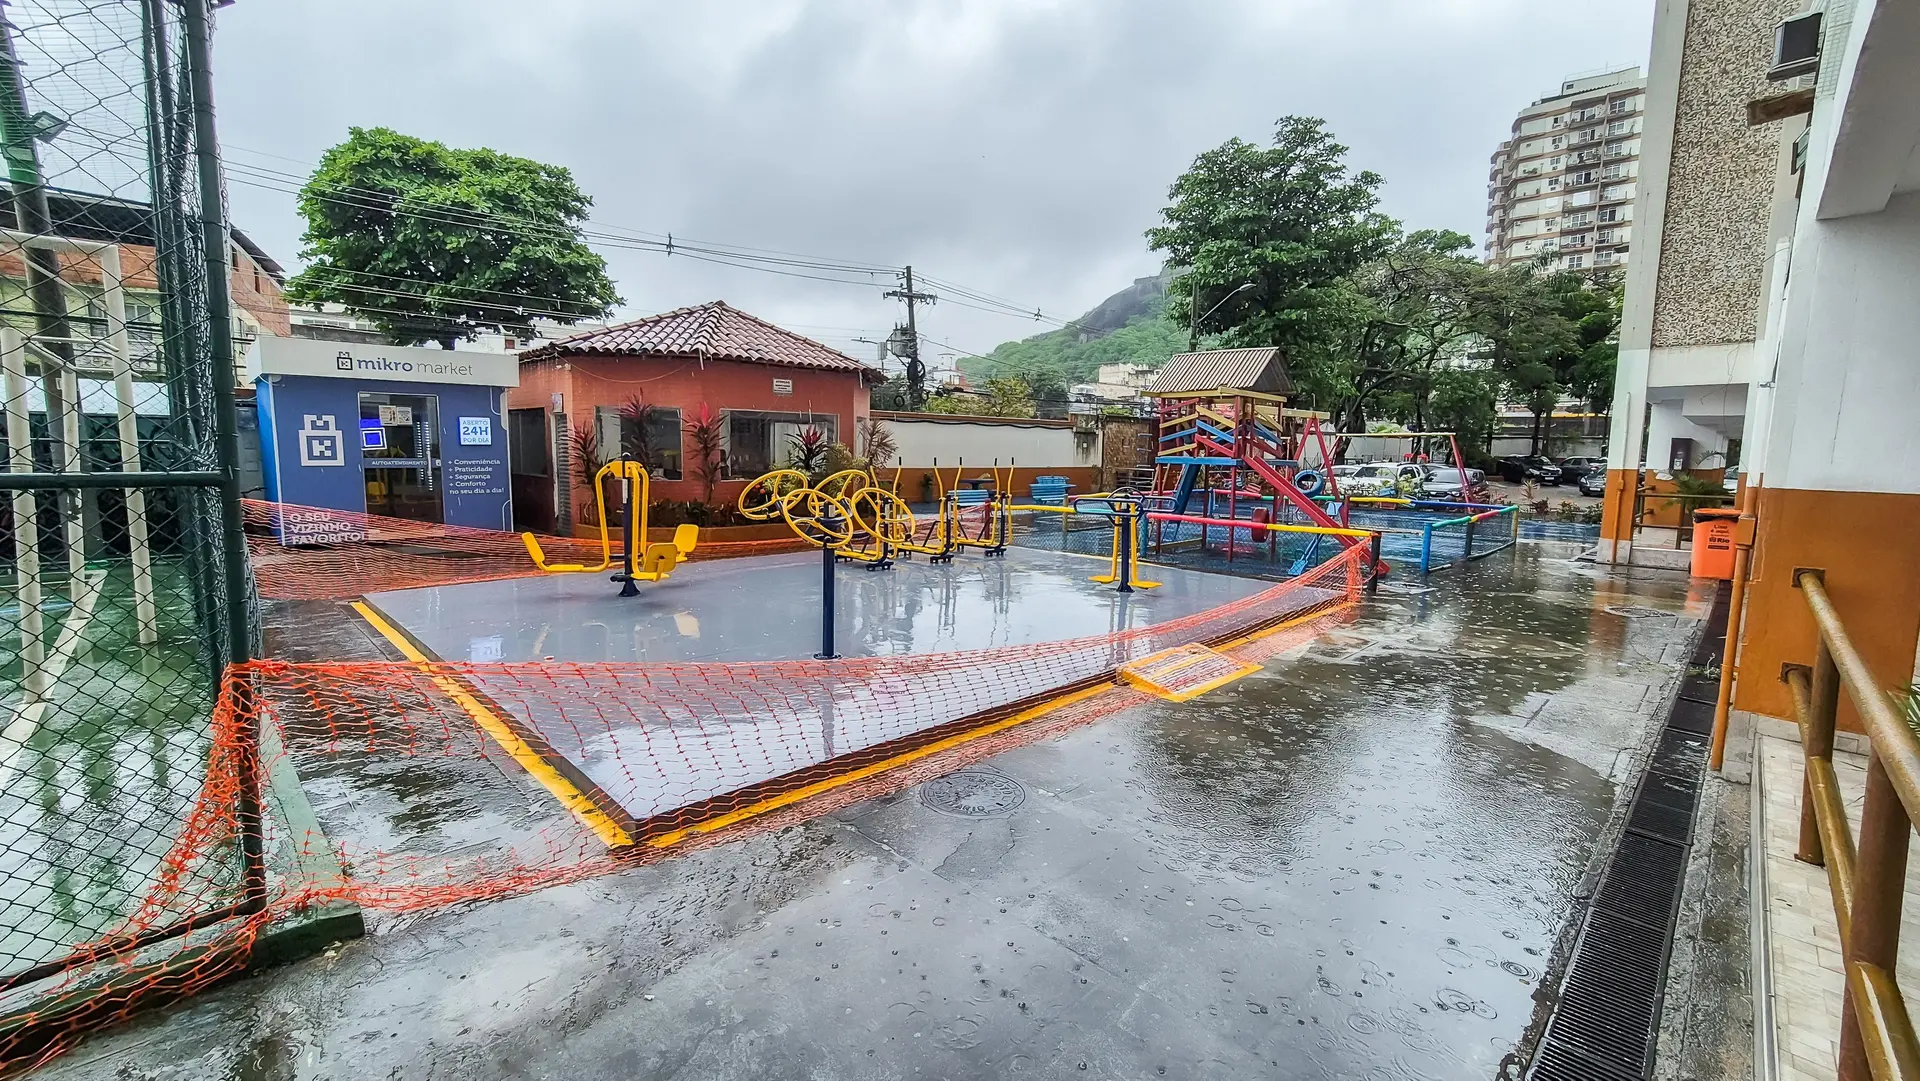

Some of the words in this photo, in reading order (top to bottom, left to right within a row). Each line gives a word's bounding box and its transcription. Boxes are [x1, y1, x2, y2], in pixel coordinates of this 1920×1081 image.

[357, 357, 413, 372] mikro
[416, 362, 473, 376] market
[462, 426, 488, 436] 24H
[290, 514, 301, 522] O
[306, 512, 330, 522] SEU
[290, 522, 350, 533] VIZINHO
